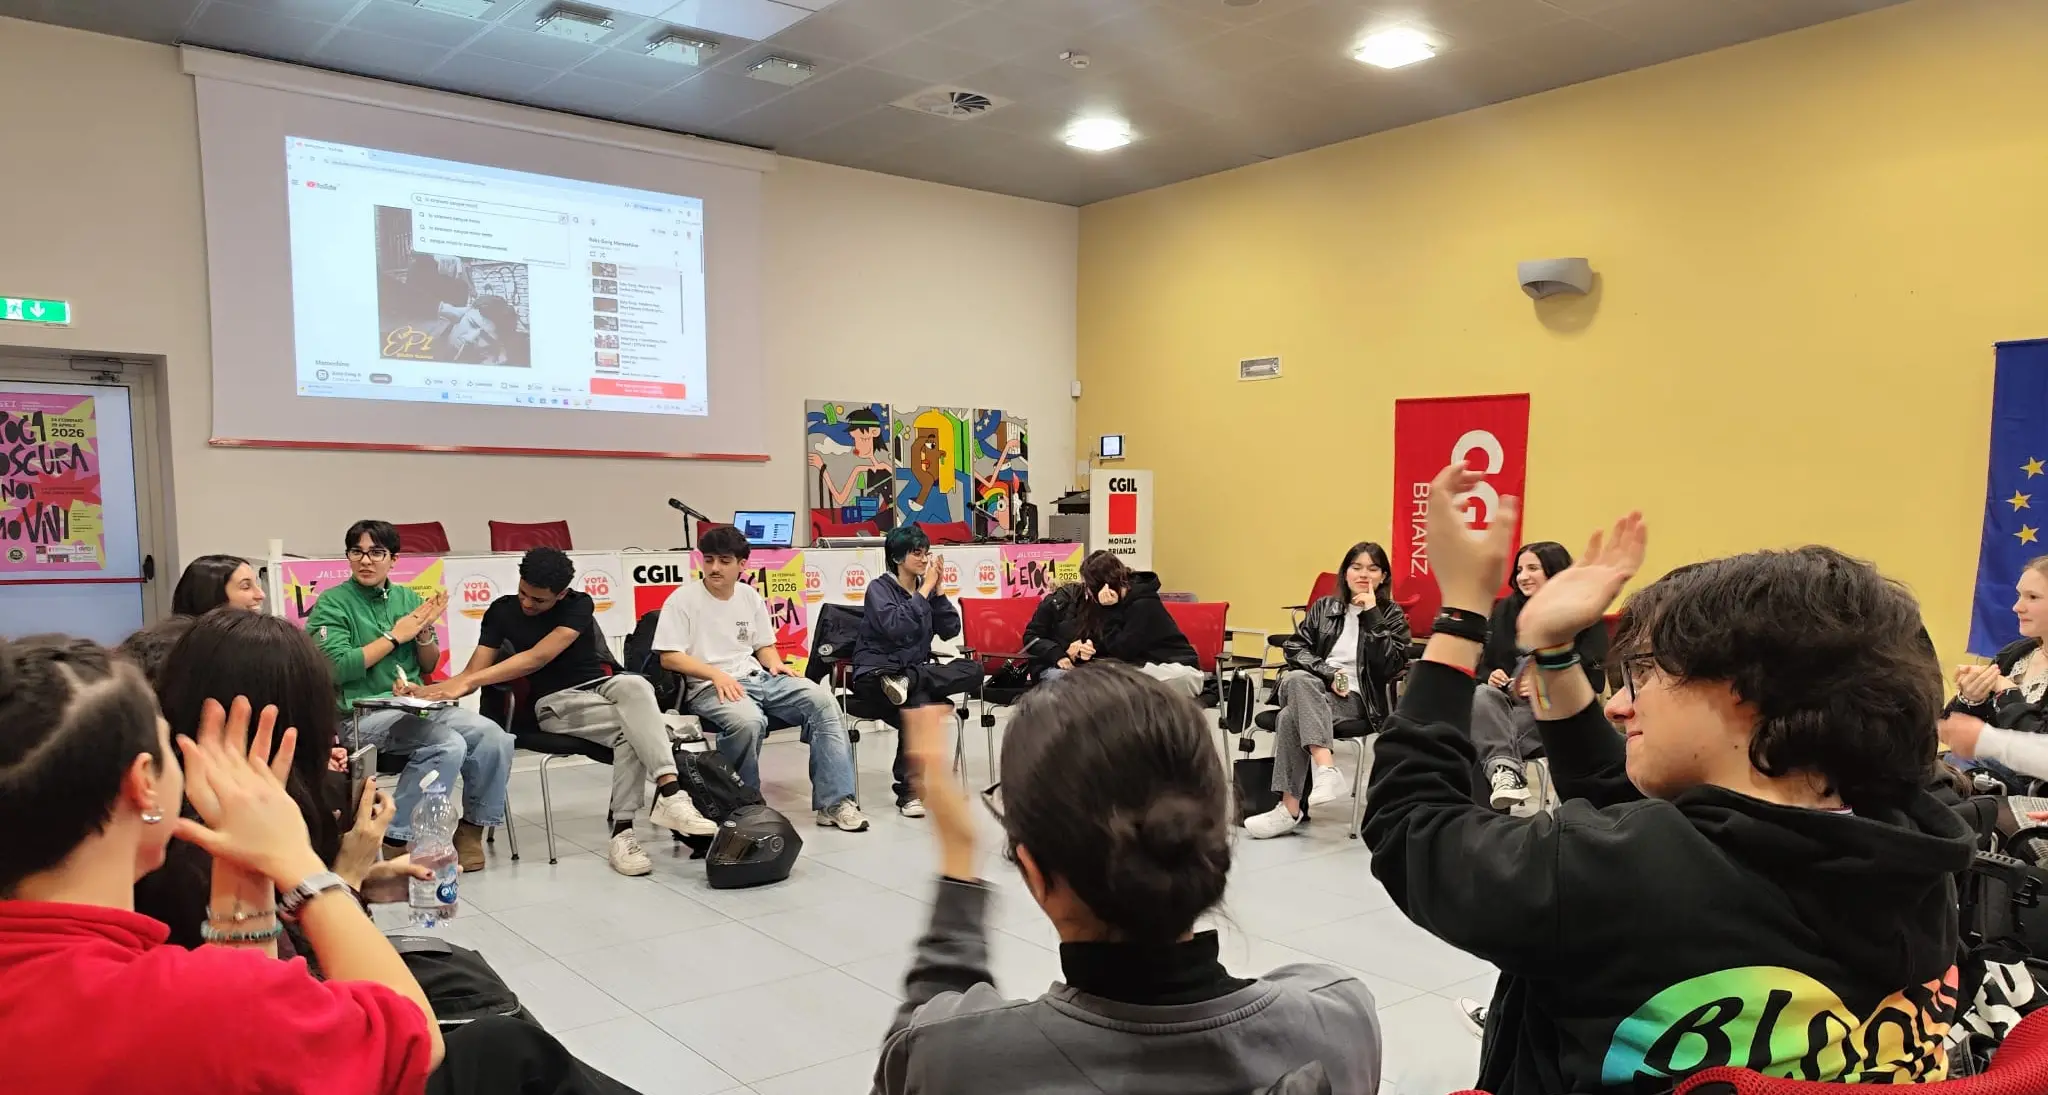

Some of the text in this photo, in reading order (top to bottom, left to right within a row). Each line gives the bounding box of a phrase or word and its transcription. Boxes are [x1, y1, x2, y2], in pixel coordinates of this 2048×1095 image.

[51, 428, 85, 438] 2026
[1, 479, 35, 502] NOI
[1108, 477, 1137, 492] CGIL
[1410, 482, 1432, 578] BRIANZ
[633, 565, 683, 584] CGIL
[943, 573, 957, 583] NO
[979, 572, 995, 581] NO
[1006, 560, 1056, 589] L'EPOCA
[1059, 572, 1078, 581] 2026
[846, 576, 865, 587] NO
[585, 583, 609, 596] NO
[772, 583, 797, 593] 2026
[464, 590, 491, 602] NO
